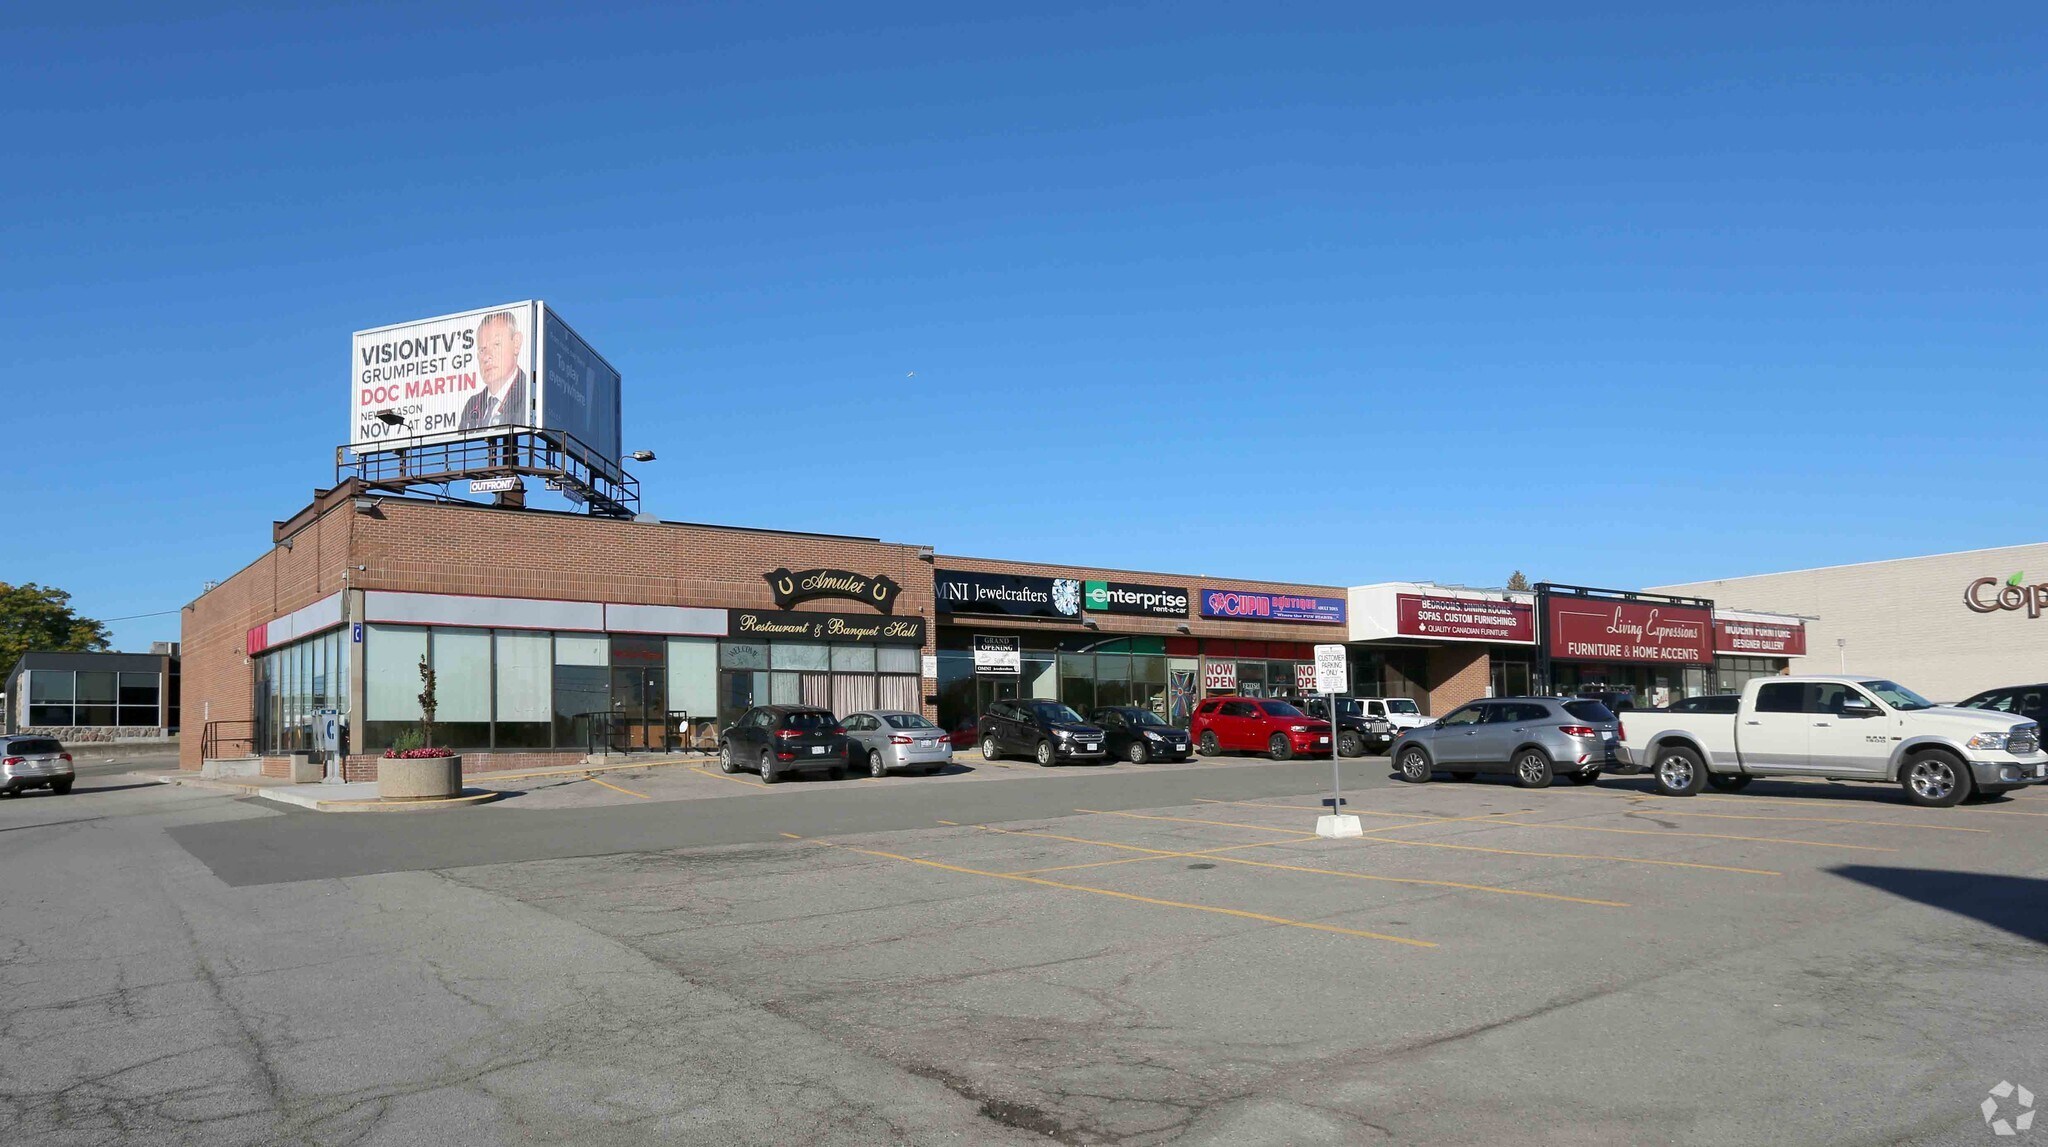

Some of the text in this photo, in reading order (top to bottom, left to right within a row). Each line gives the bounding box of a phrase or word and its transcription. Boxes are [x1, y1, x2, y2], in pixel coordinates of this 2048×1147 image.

[361, 329, 475, 366] VISIONTV'S
[362, 353, 473, 384] GRUMPIEST GP
[361, 372, 477, 406] DOC MARTIN
[360, 422, 391, 440] NOV
[407, 418, 421, 431] AT
[424, 412, 456, 431] 8PM
[471, 479, 512, 491] OUTFRONT
[801, 570, 867, 594] Amulet
[934, 582, 1048, 603] MNI Jewelcrafters
[1090, 588, 1187, 610] enterprise
[1153, 606, 1187, 614] rent-a-car
[1224, 593, 1317, 617] CUPID BOUTIQUE
[1464, 603, 1487, 613] DINING
[1444, 612, 1473, 624] CUSTOM
[1474, 615, 1517, 626] FURNISHINGS
[1606, 605, 1698, 644] Living Expressions
[739, 614, 919, 641] Restaurant & Banquet Hall
[1428, 624, 1509, 637] QUALITY CANADIAN FURNITURE
[1754, 626, 1791, 638] FURNITURE
[1568, 642, 1698, 660] FURNITURE & HOME ACCENTS
[1733, 638, 1785, 651] DESIGNER GALLERY
[1206, 664, 1233, 675] NOW
[1298, 666, 1316, 676] NO
[1205, 676, 1236, 688] OPEN
[1297, 677, 1317, 688] OPE
